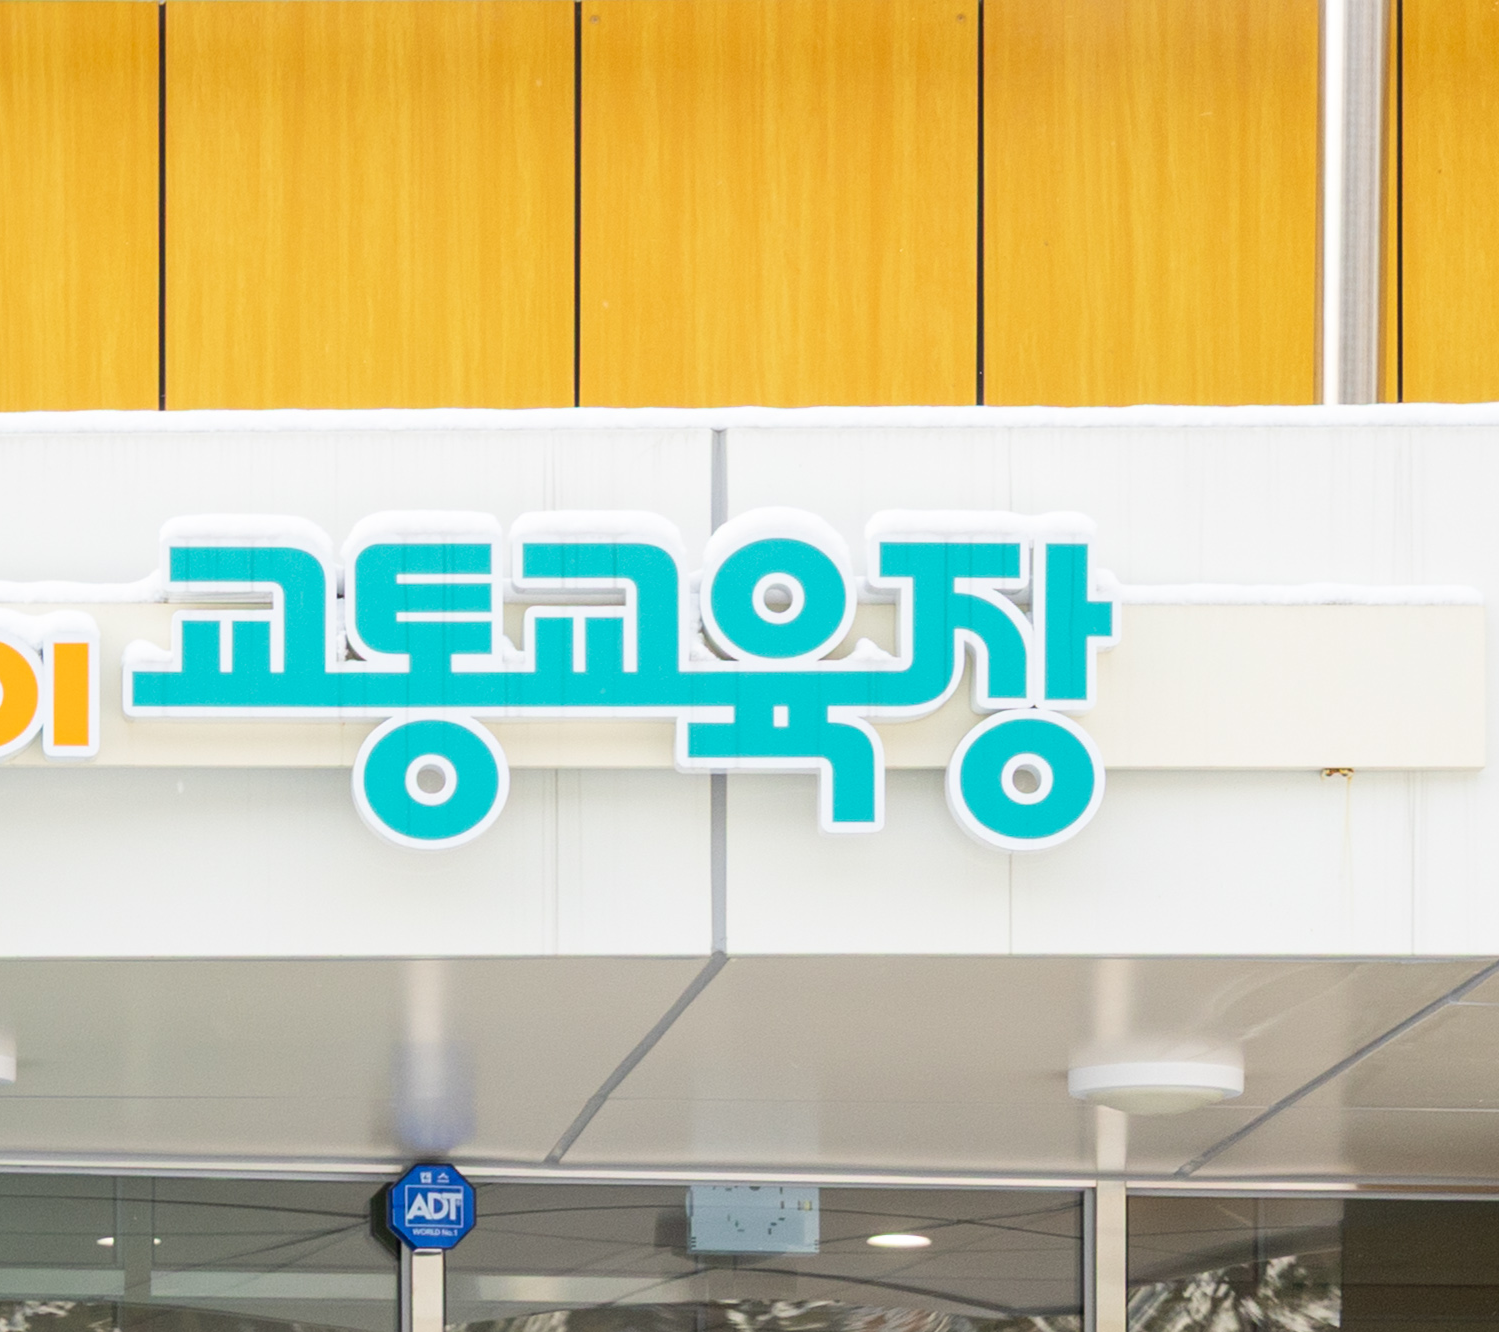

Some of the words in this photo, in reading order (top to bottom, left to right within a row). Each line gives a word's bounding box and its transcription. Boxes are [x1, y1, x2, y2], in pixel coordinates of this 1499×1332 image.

[131, 538, 1113, 841] 교통교육장
[407, 1191, 462, 1220] ADT
[412, 1228, 441, 1236] WORLD
